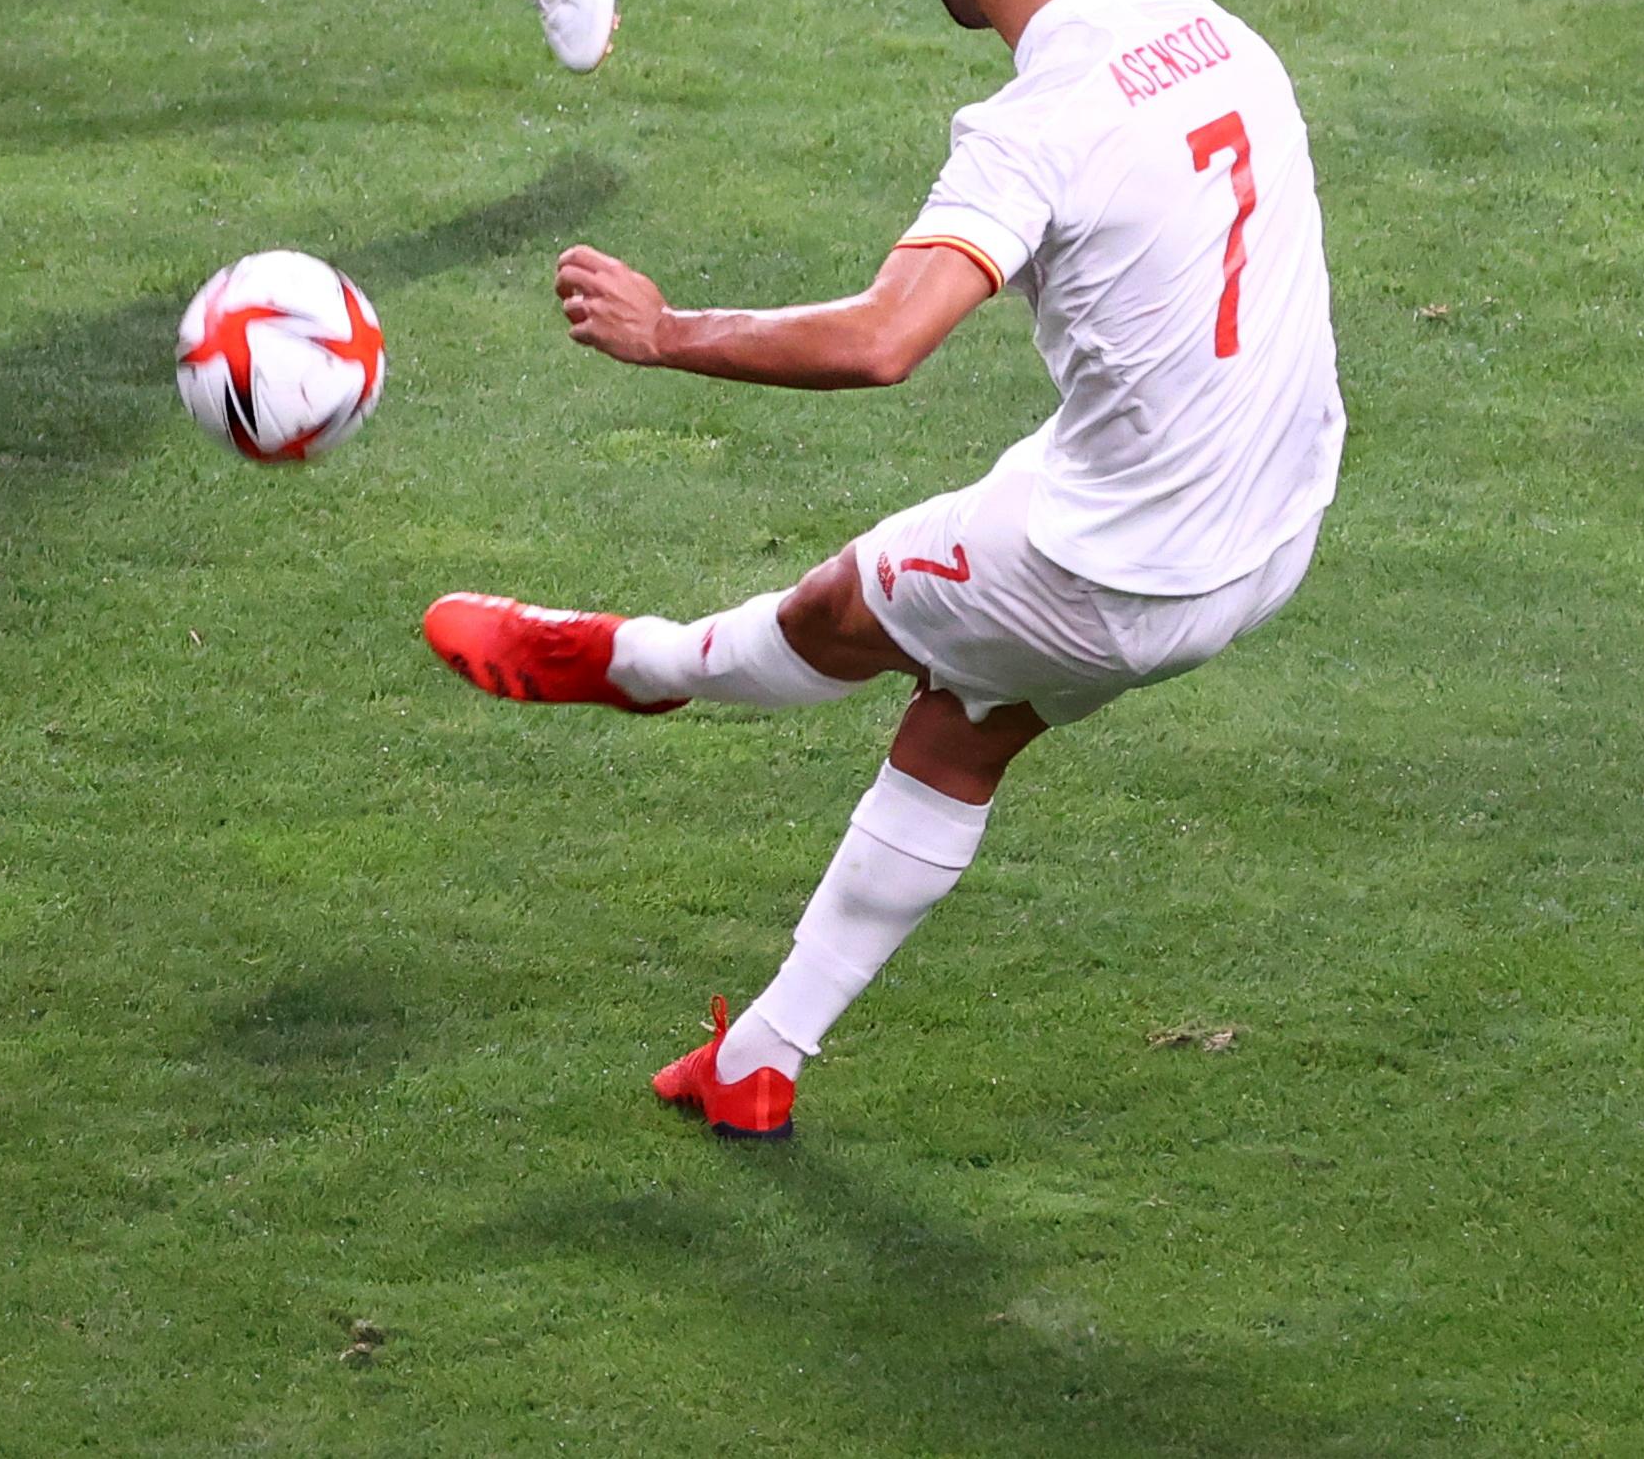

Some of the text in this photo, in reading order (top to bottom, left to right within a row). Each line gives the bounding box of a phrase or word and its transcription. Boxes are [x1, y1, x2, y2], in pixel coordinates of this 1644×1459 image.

[1109, 17, 1232, 107] ASENSIO
[1186, 110, 1257, 359] 7
[900, 543, 971, 583] 7
